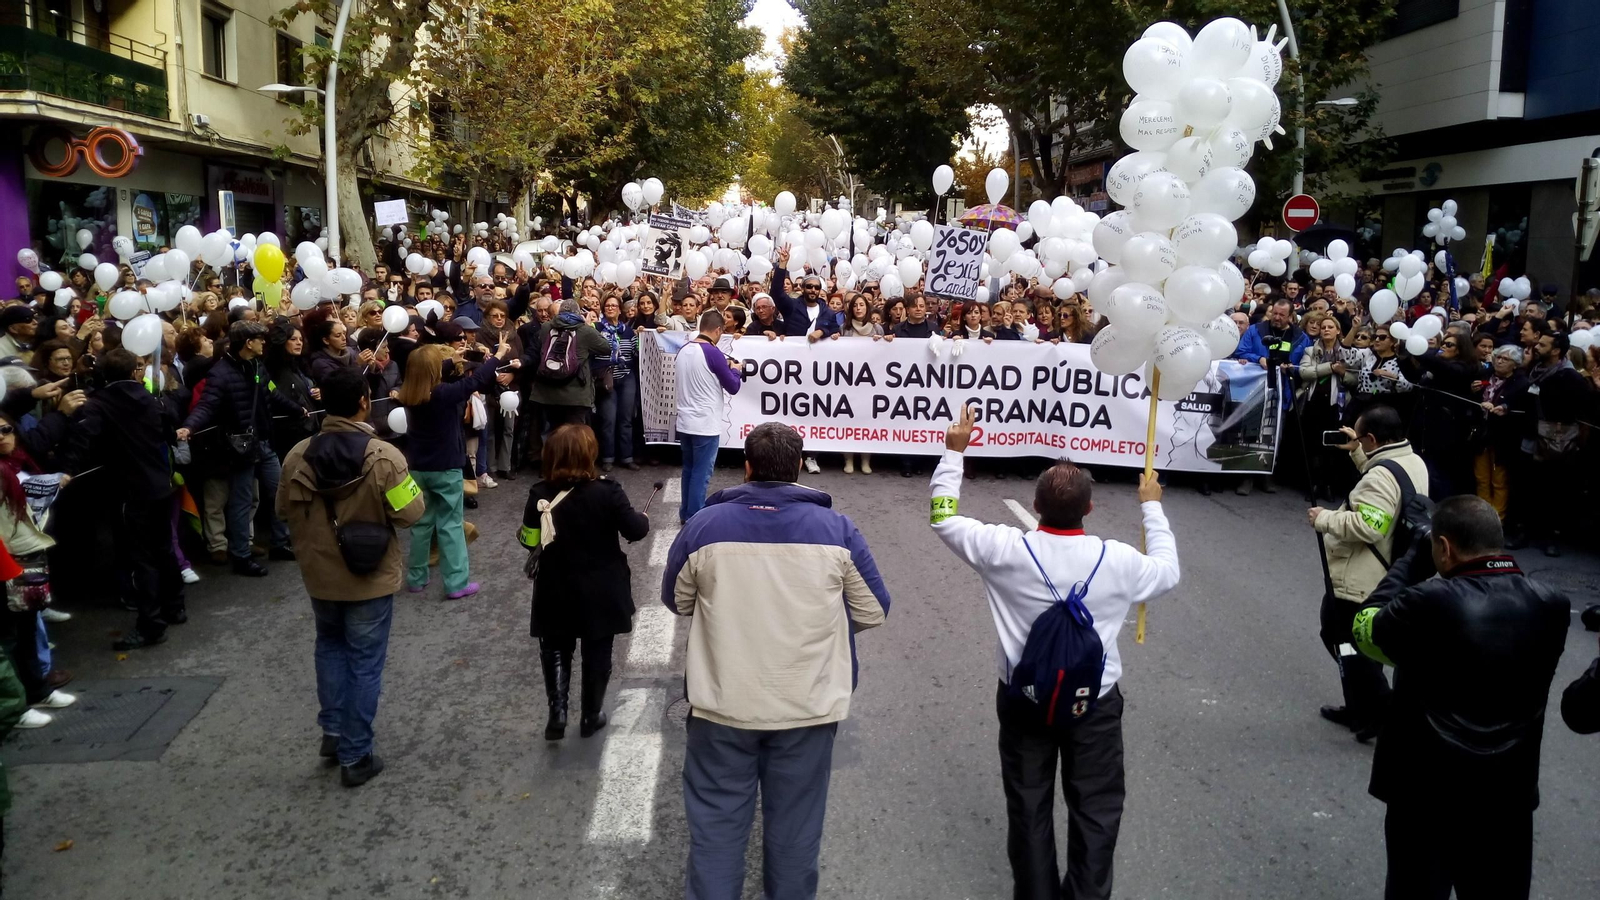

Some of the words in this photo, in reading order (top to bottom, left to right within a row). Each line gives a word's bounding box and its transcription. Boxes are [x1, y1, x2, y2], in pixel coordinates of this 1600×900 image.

[931, 249, 980, 282] Jesús
[930, 273, 978, 298] Candel
[742, 358, 803, 386] POR
[813, 360, 876, 387] UNA
[885, 361, 1022, 391] SANIDAD
[760, 391, 855, 419] DIGNA
[872, 394, 953, 422] PARA
[966, 397, 1112, 430] GRANADA
[1181, 402, 1212, 412] SALUD
[810, 426, 889, 442] RECUPERAR
[892, 429, 945, 444] NUESTR
[988, 432, 1067, 448] HOSPITALES
[1070, 437, 1159, 457] COMPLETO!
[1485, 560, 1514, 568] Canon
